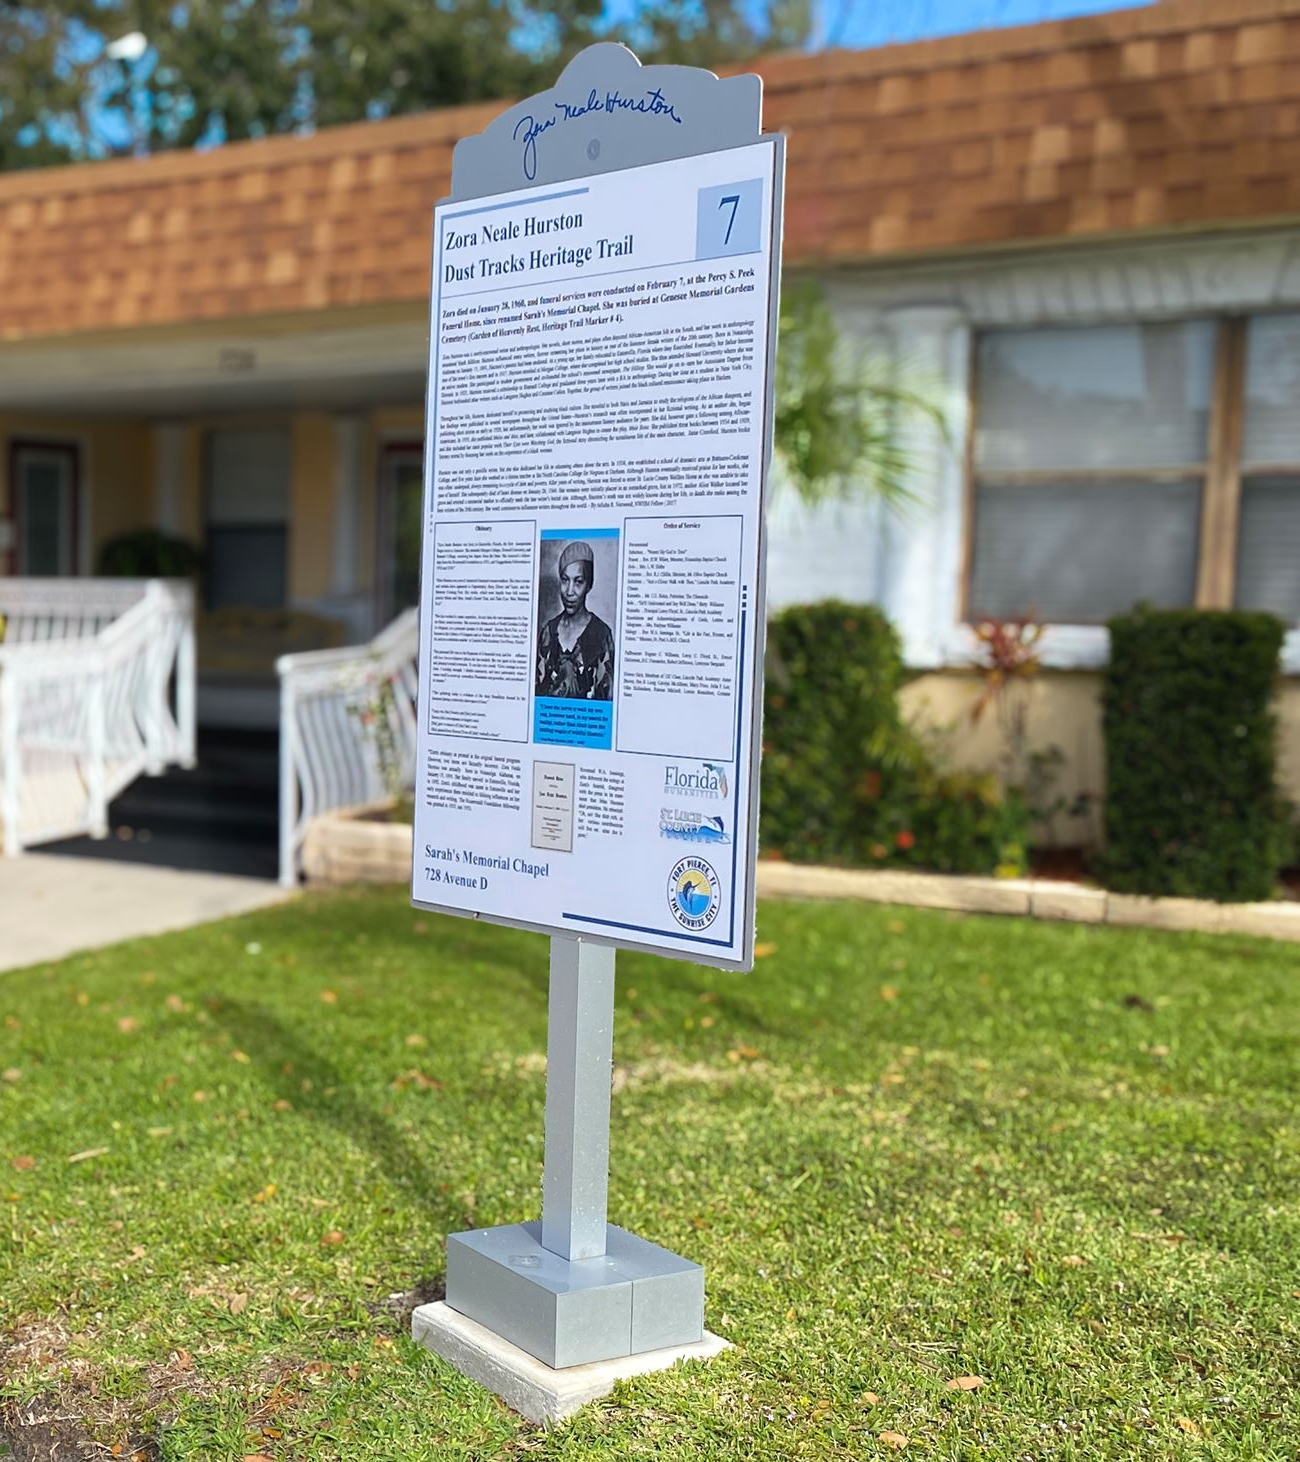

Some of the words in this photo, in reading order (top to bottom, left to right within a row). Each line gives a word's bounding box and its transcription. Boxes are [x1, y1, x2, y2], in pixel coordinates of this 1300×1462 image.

[445, 231, 477, 250] Zora
[481, 221, 520, 245] Neale
[523, 213, 583, 237] Hurston
[718, 195, 741, 245] 7
[444, 259, 475, 283] Dust
[479, 251, 525, 277] Tracks
[529, 244, 592, 270] Heritage
[596, 234, 634, 258] Trail
[442, 308, 455, 318] Zora
[456, 306, 467, 316] died
[469, 305, 476, 314] on
[476, 302, 499, 315] January
[527, 297, 538, 306] and
[539, 294, 560, 305] funeral
[562, 290, 585, 302] services
[587, 288, 601, 298] were
[602, 283, 635, 296] conducted
[636, 282, 644, 291] on
[646, 277, 676, 292] February
[678, 276, 685, 287] 7,
[687, 275, 693, 285] at
[694, 273, 705, 284] the
[707, 270, 727, 284] Percy
[728, 269, 736, 279] S.
[442, 320, 463, 330] Funeral
[482, 315, 496, 325] since
[497, 312, 522, 323] renamed
[523, 309, 545, 320] Sarah's
[546, 305, 576, 317] Memorial
[602, 300, 614, 310] She
[615, 298, 627, 308] was
[628, 295, 650, 306] buried
[651, 294, 658, 303] at
[689, 285, 722, 298] Memorial
[724, 281, 754, 294] Gardens
[441, 333, 466, 345] Cemetery
[467, 330, 490, 342] (Garden
[491, 329, 498, 337] of
[541, 320, 567, 333] Heritage
[568, 318, 583, 328] Trail
[585, 315, 608, 326] Marker
[665, 766, 718, 790] Florida
[425, 844, 460, 862] Sarah's
[462, 850, 510, 870] Memorial
[513, 858, 549, 878] Chapel
[672, 863, 685, 882] FORT
[425, 867, 441, 881] 728
[442, 871, 477, 888] Avenue
[479, 877, 488, 890] D
[670, 898, 679, 915] THE
[678, 912, 706, 928] SUNRISE
[706, 903, 718, 922] CITY
